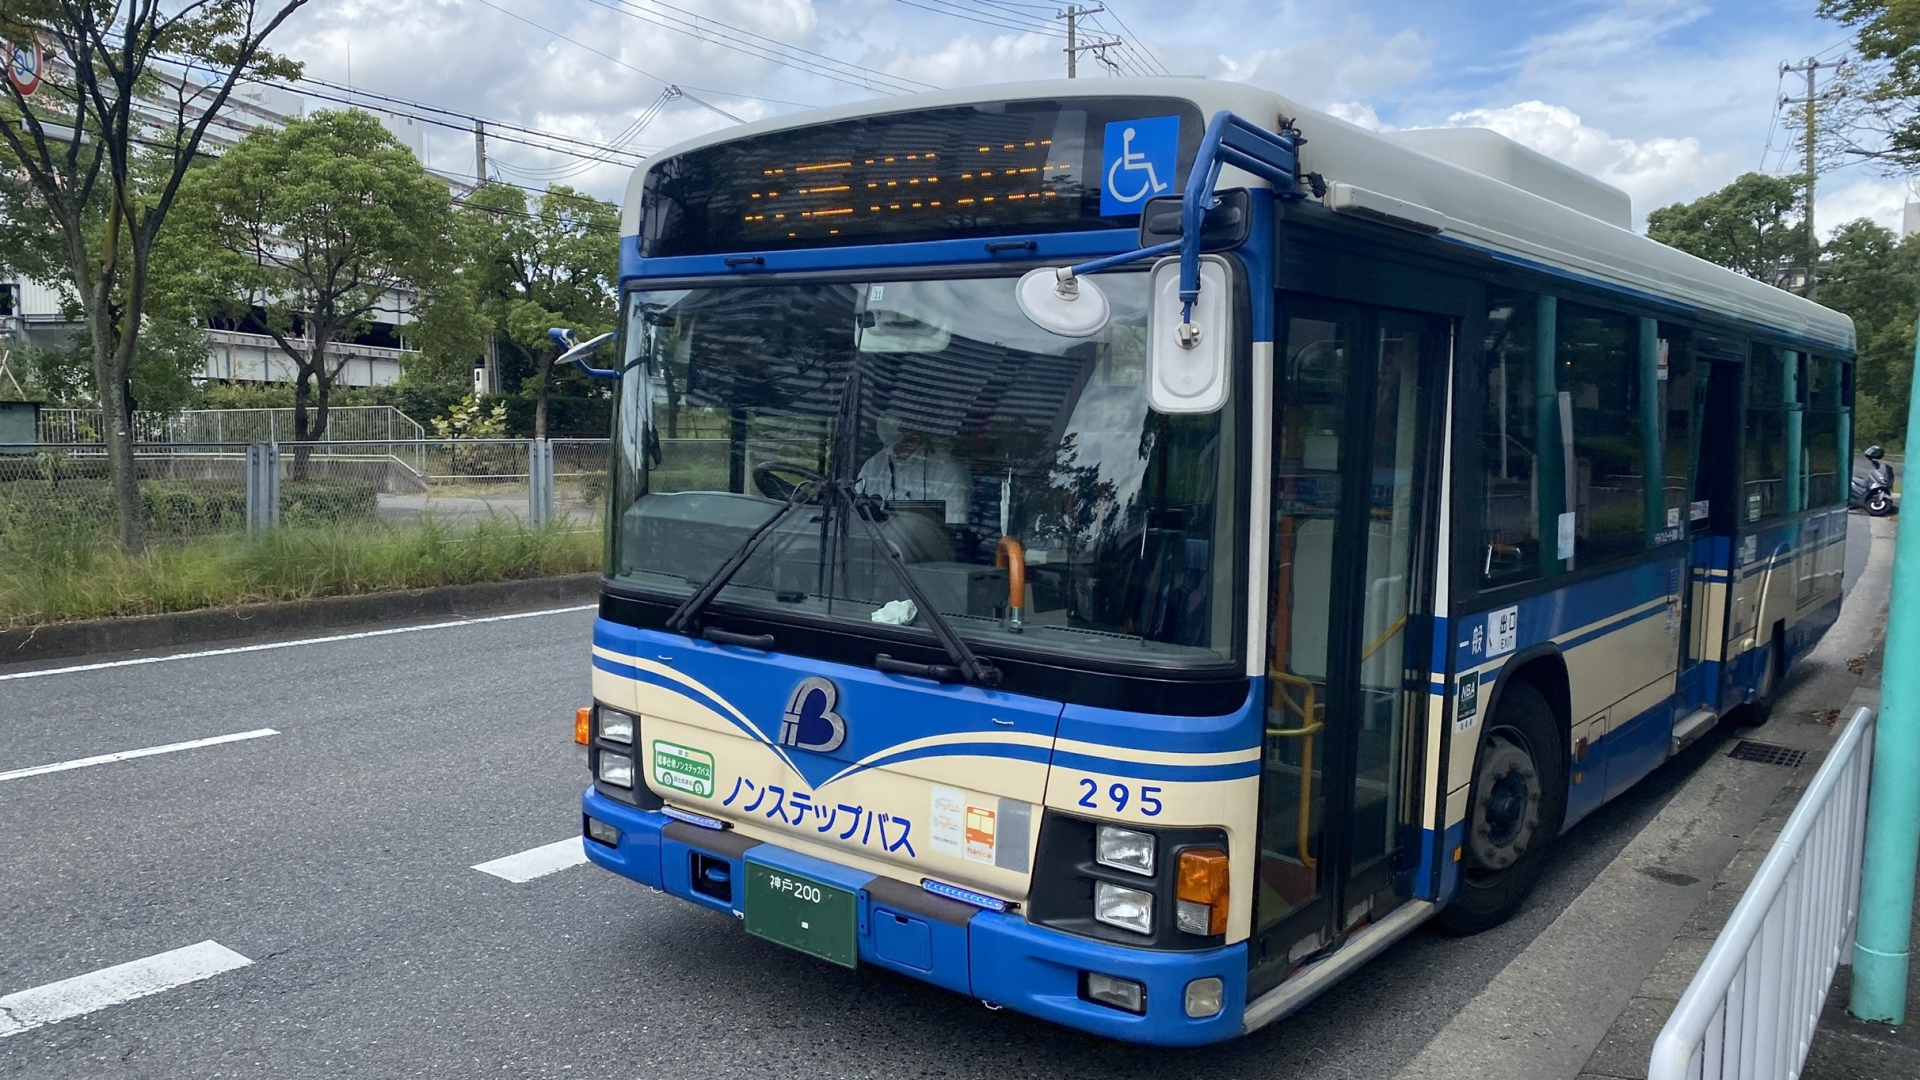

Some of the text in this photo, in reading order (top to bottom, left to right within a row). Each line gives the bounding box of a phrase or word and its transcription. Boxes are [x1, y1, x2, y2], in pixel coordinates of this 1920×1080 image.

[1499, 612, 1516, 635] 出口
[1459, 624, 1484, 655] 一般
[1500, 635, 1514, 650] EXIT
[1461, 682, 1475, 699] NBA
[1077, 778, 1164, 817] 295
[722, 775, 916, 858] ノンステップバス
[966, 846, 992, 859] hanica
